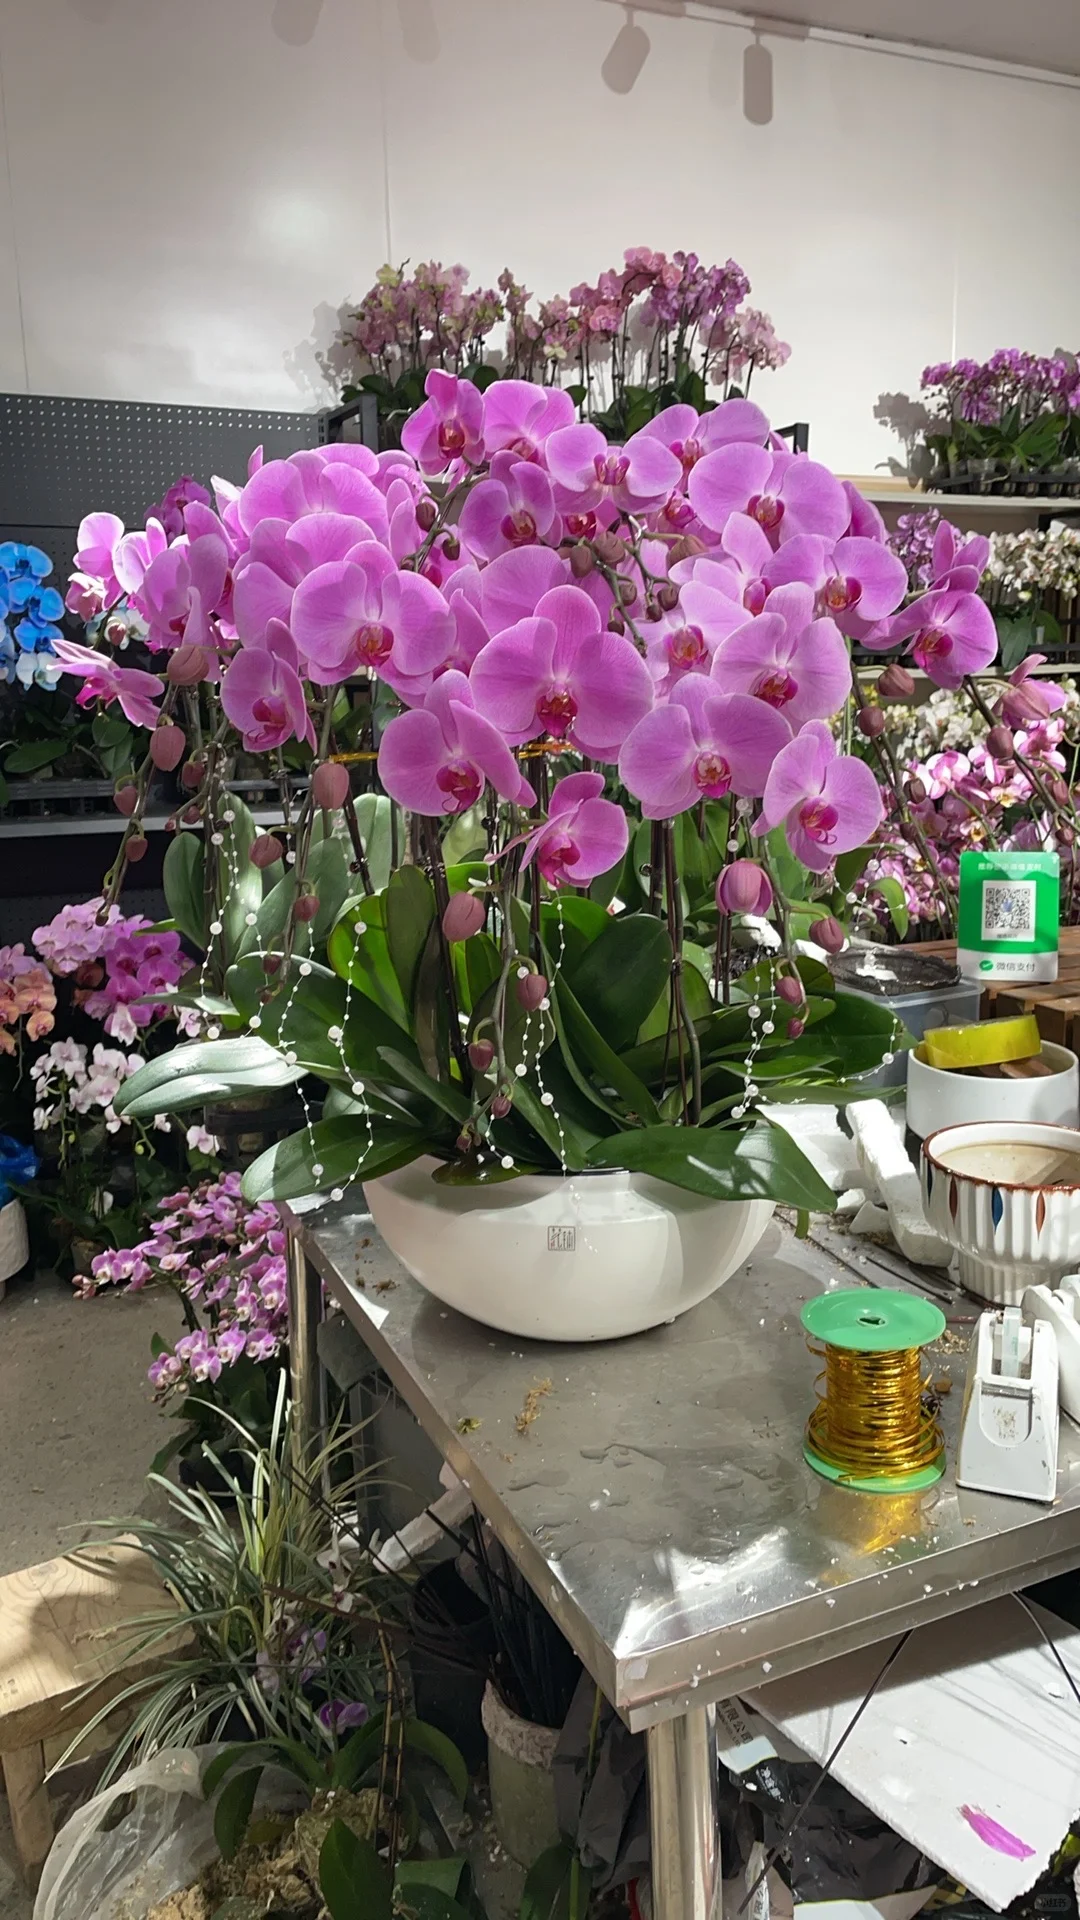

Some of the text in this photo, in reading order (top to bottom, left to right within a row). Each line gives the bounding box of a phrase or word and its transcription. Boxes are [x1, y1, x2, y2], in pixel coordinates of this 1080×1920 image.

[996, 961, 1036, 973] 微信支付
[718, 1699, 754, 1744] 有限公司
